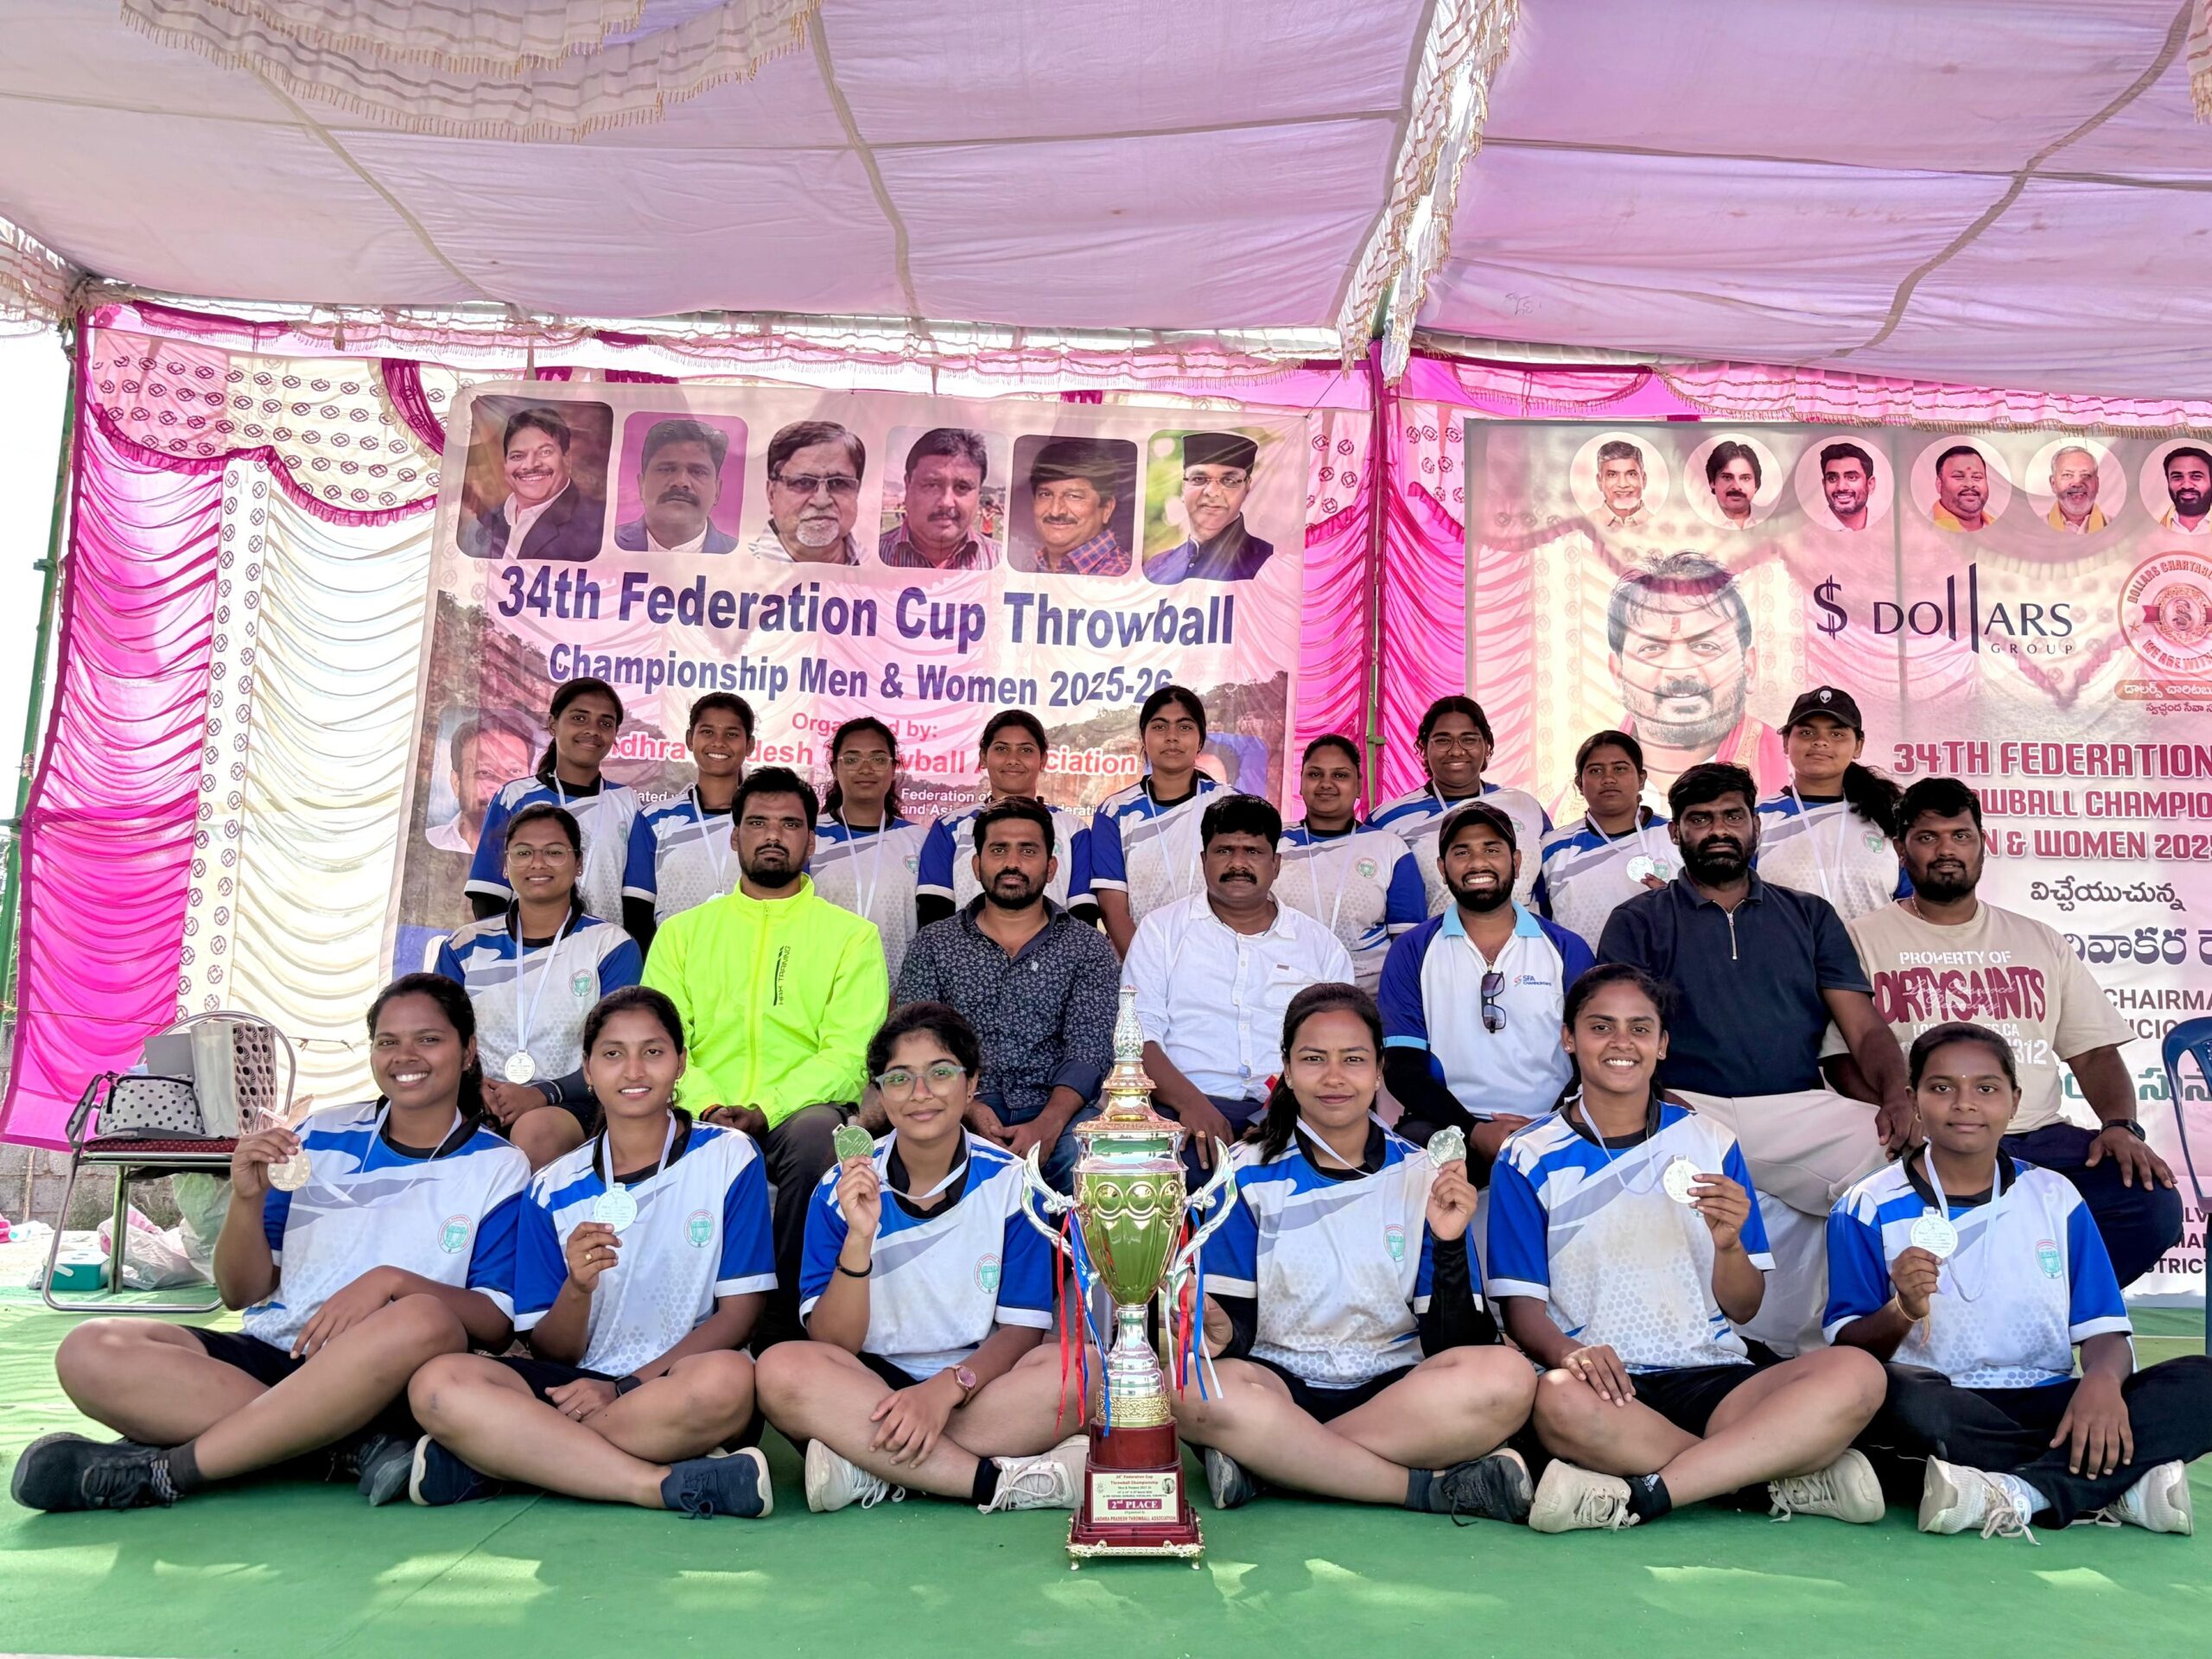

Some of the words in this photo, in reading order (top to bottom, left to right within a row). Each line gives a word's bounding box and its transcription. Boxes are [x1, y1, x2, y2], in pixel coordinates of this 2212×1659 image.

[2127, 566, 2161, 604] DOLLARS
[498, 565, 601, 620] 34th
[619, 571, 876, 637] Federation
[896, 587, 986, 654] Cup
[1003, 592, 1234, 648] Throwball
[1990, 643, 2074, 655] GROUP
[550, 644, 788, 701] Championship
[799, 657, 868, 696] Men
[880, 662, 904, 699] &
[918, 664, 1036, 706] Women
[906, 720, 938, 741] by:
[1893, 741, 1989, 774] 34TH
[2000, 742, 2212, 777] FEDERATION
[900, 787, 975, 803] Federation
[900, 804, 926, 815] and
[2006, 830, 2026, 856] &
[2033, 830, 2146, 859] WOMEN
[1899, 950, 1985, 965] PROPERTY
[1989, 950, 2012, 964] OF
[1125, 1500, 1158, 1509] PLACE
